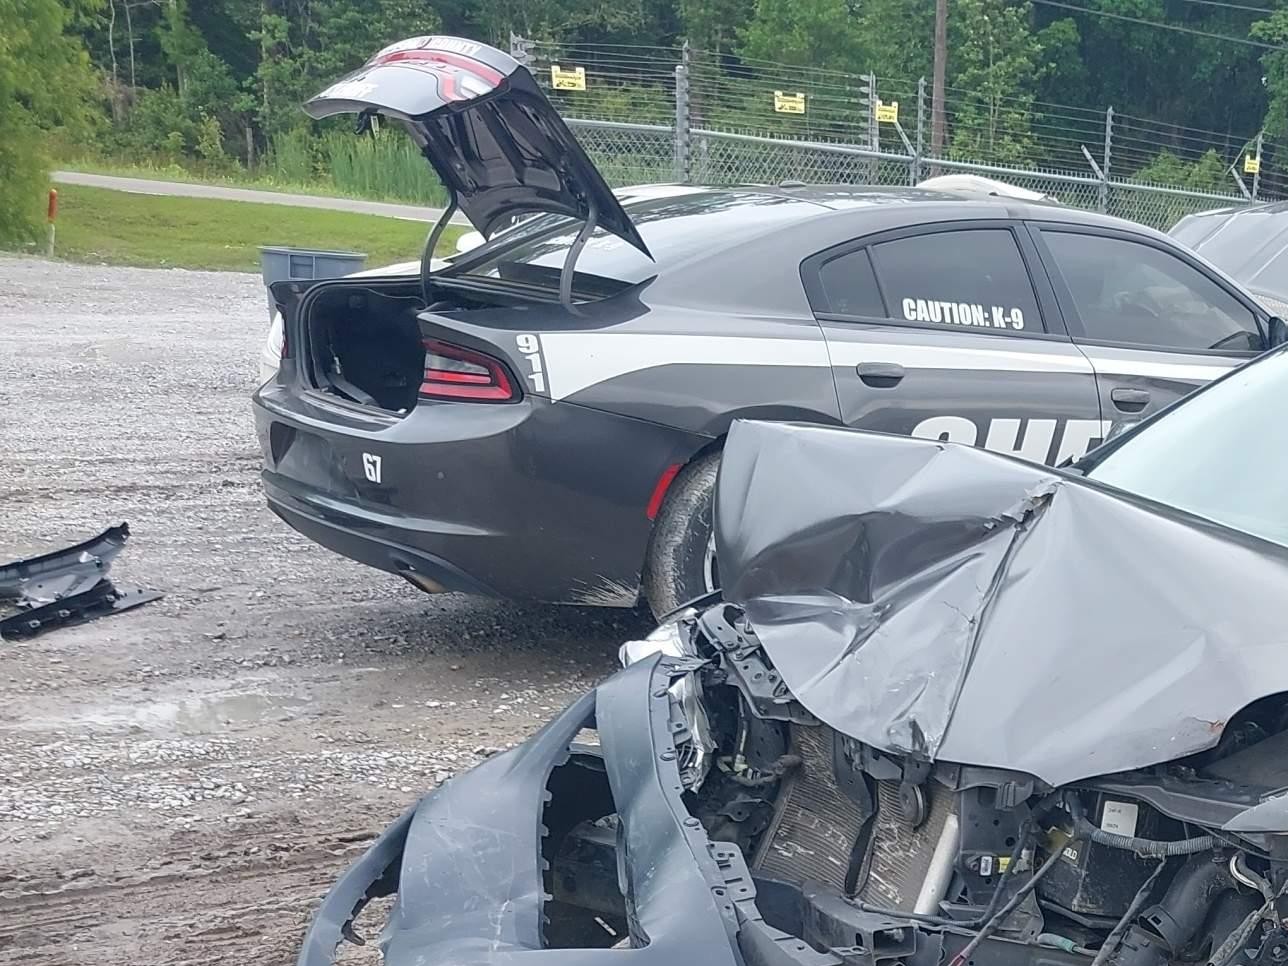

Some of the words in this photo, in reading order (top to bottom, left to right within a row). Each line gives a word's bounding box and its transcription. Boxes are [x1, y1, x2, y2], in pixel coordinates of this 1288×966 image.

[902, 298, 990, 327] CAUTION:
[992, 306, 1024, 330] K-9
[516, 334, 545, 392] 911
[362, 452, 382, 484] 67
